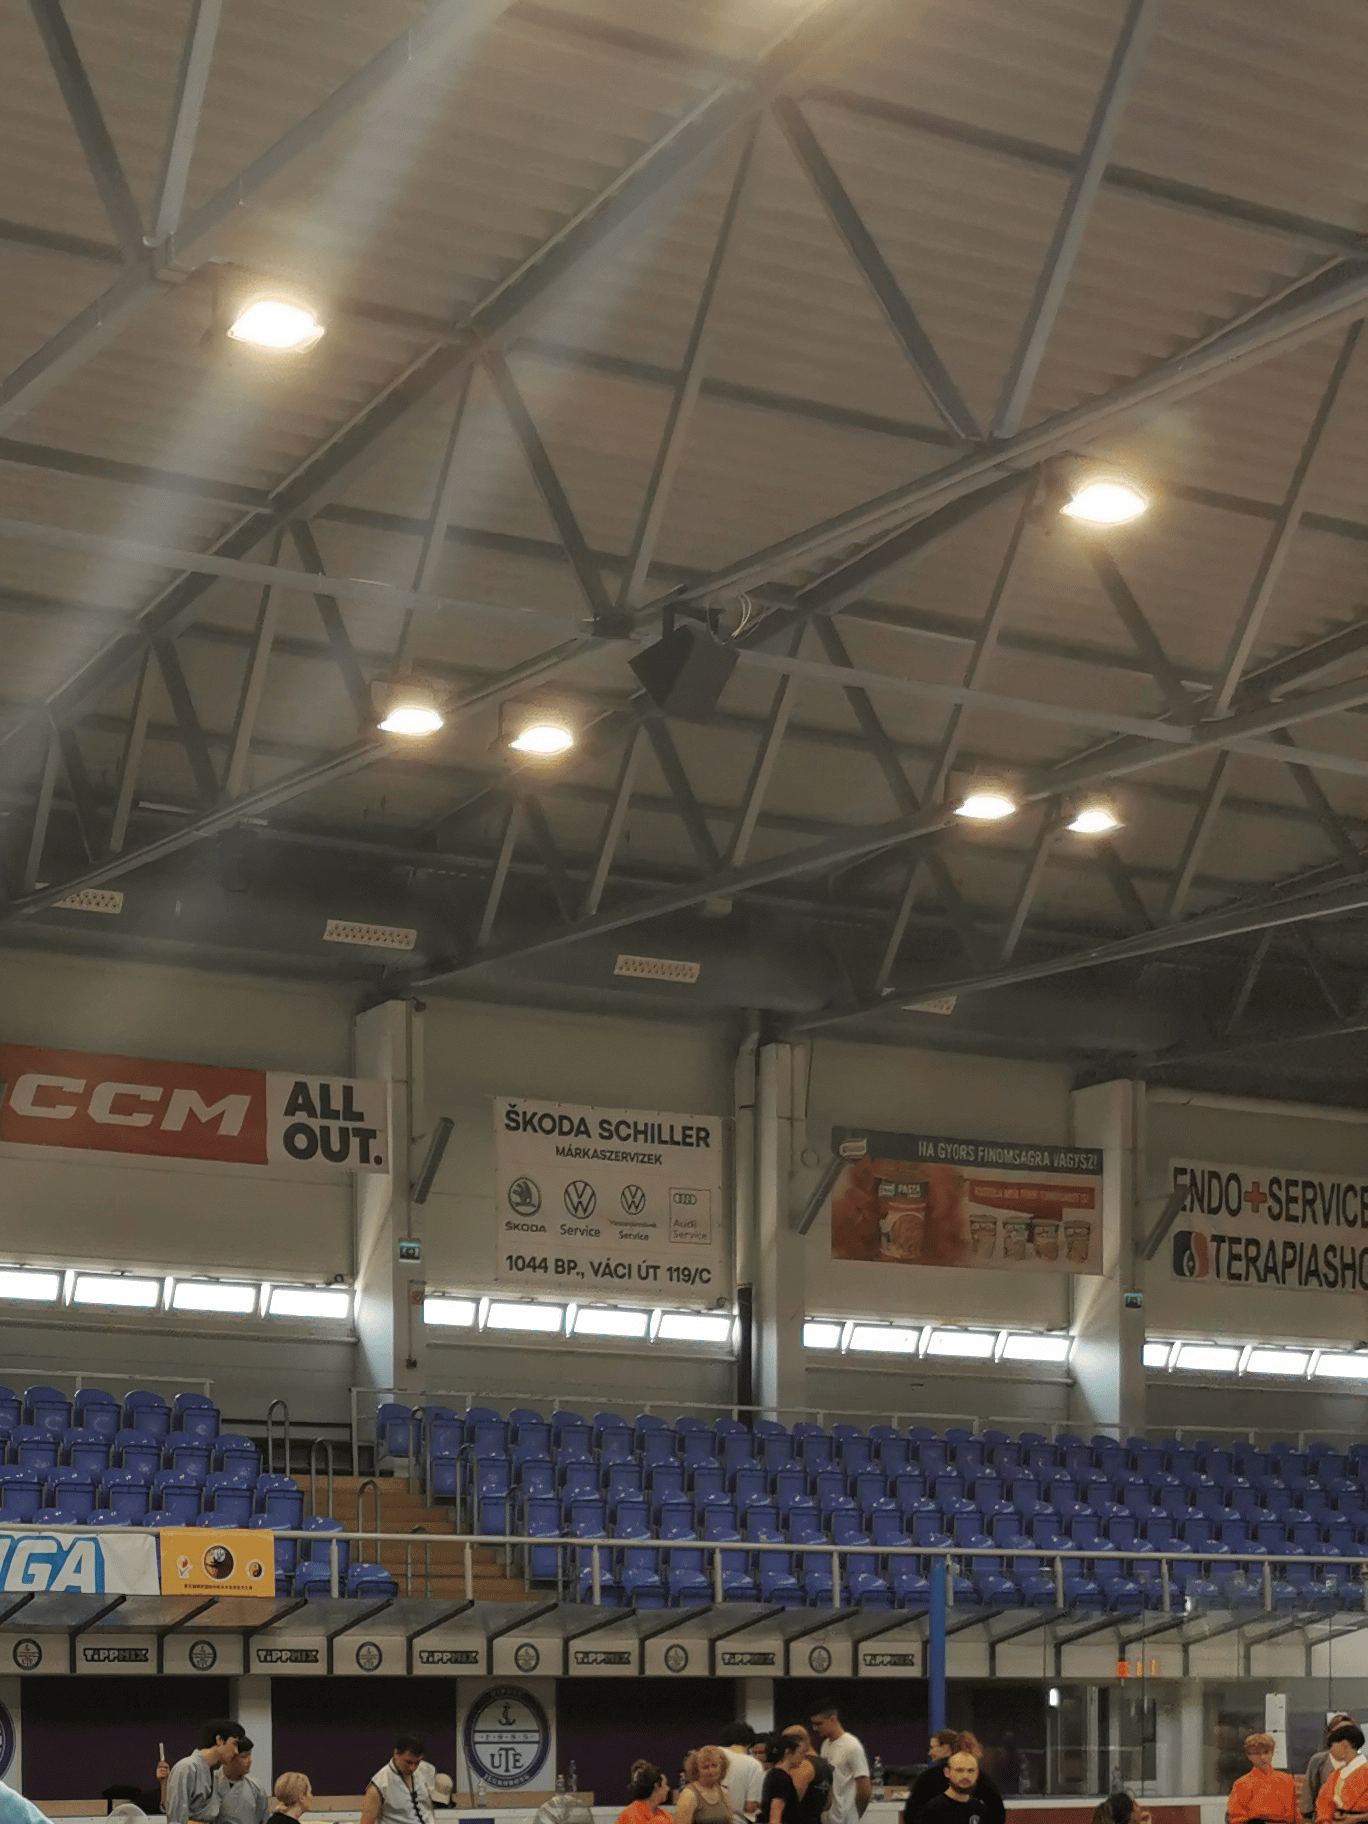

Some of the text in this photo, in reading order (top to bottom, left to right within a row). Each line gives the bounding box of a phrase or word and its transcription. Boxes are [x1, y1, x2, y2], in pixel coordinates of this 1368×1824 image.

[9, 1073, 252, 1137] CCM
[282, 1080, 365, 1122] ALL
[504, 1103, 711, 1148] ŠKODA SCHILLER
[282, 1122, 383, 1166] OUT.
[555, 1145, 663, 1166] MÁRKASZERVIZEK
[917, 1140, 935, 1158] HA
[937, 1142, 976, 1162] GYORS
[559, 1223, 601, 1238] Service
[618, 1230, 649, 1242] Service
[505, 1254, 549, 1274] 1044
[589, 1257, 632, 1280] VÁCI
[637, 1259, 661, 1282] ÚT
[665, 1265, 712, 1286] 119/C
[489, 1746, 524, 1773] UTE
